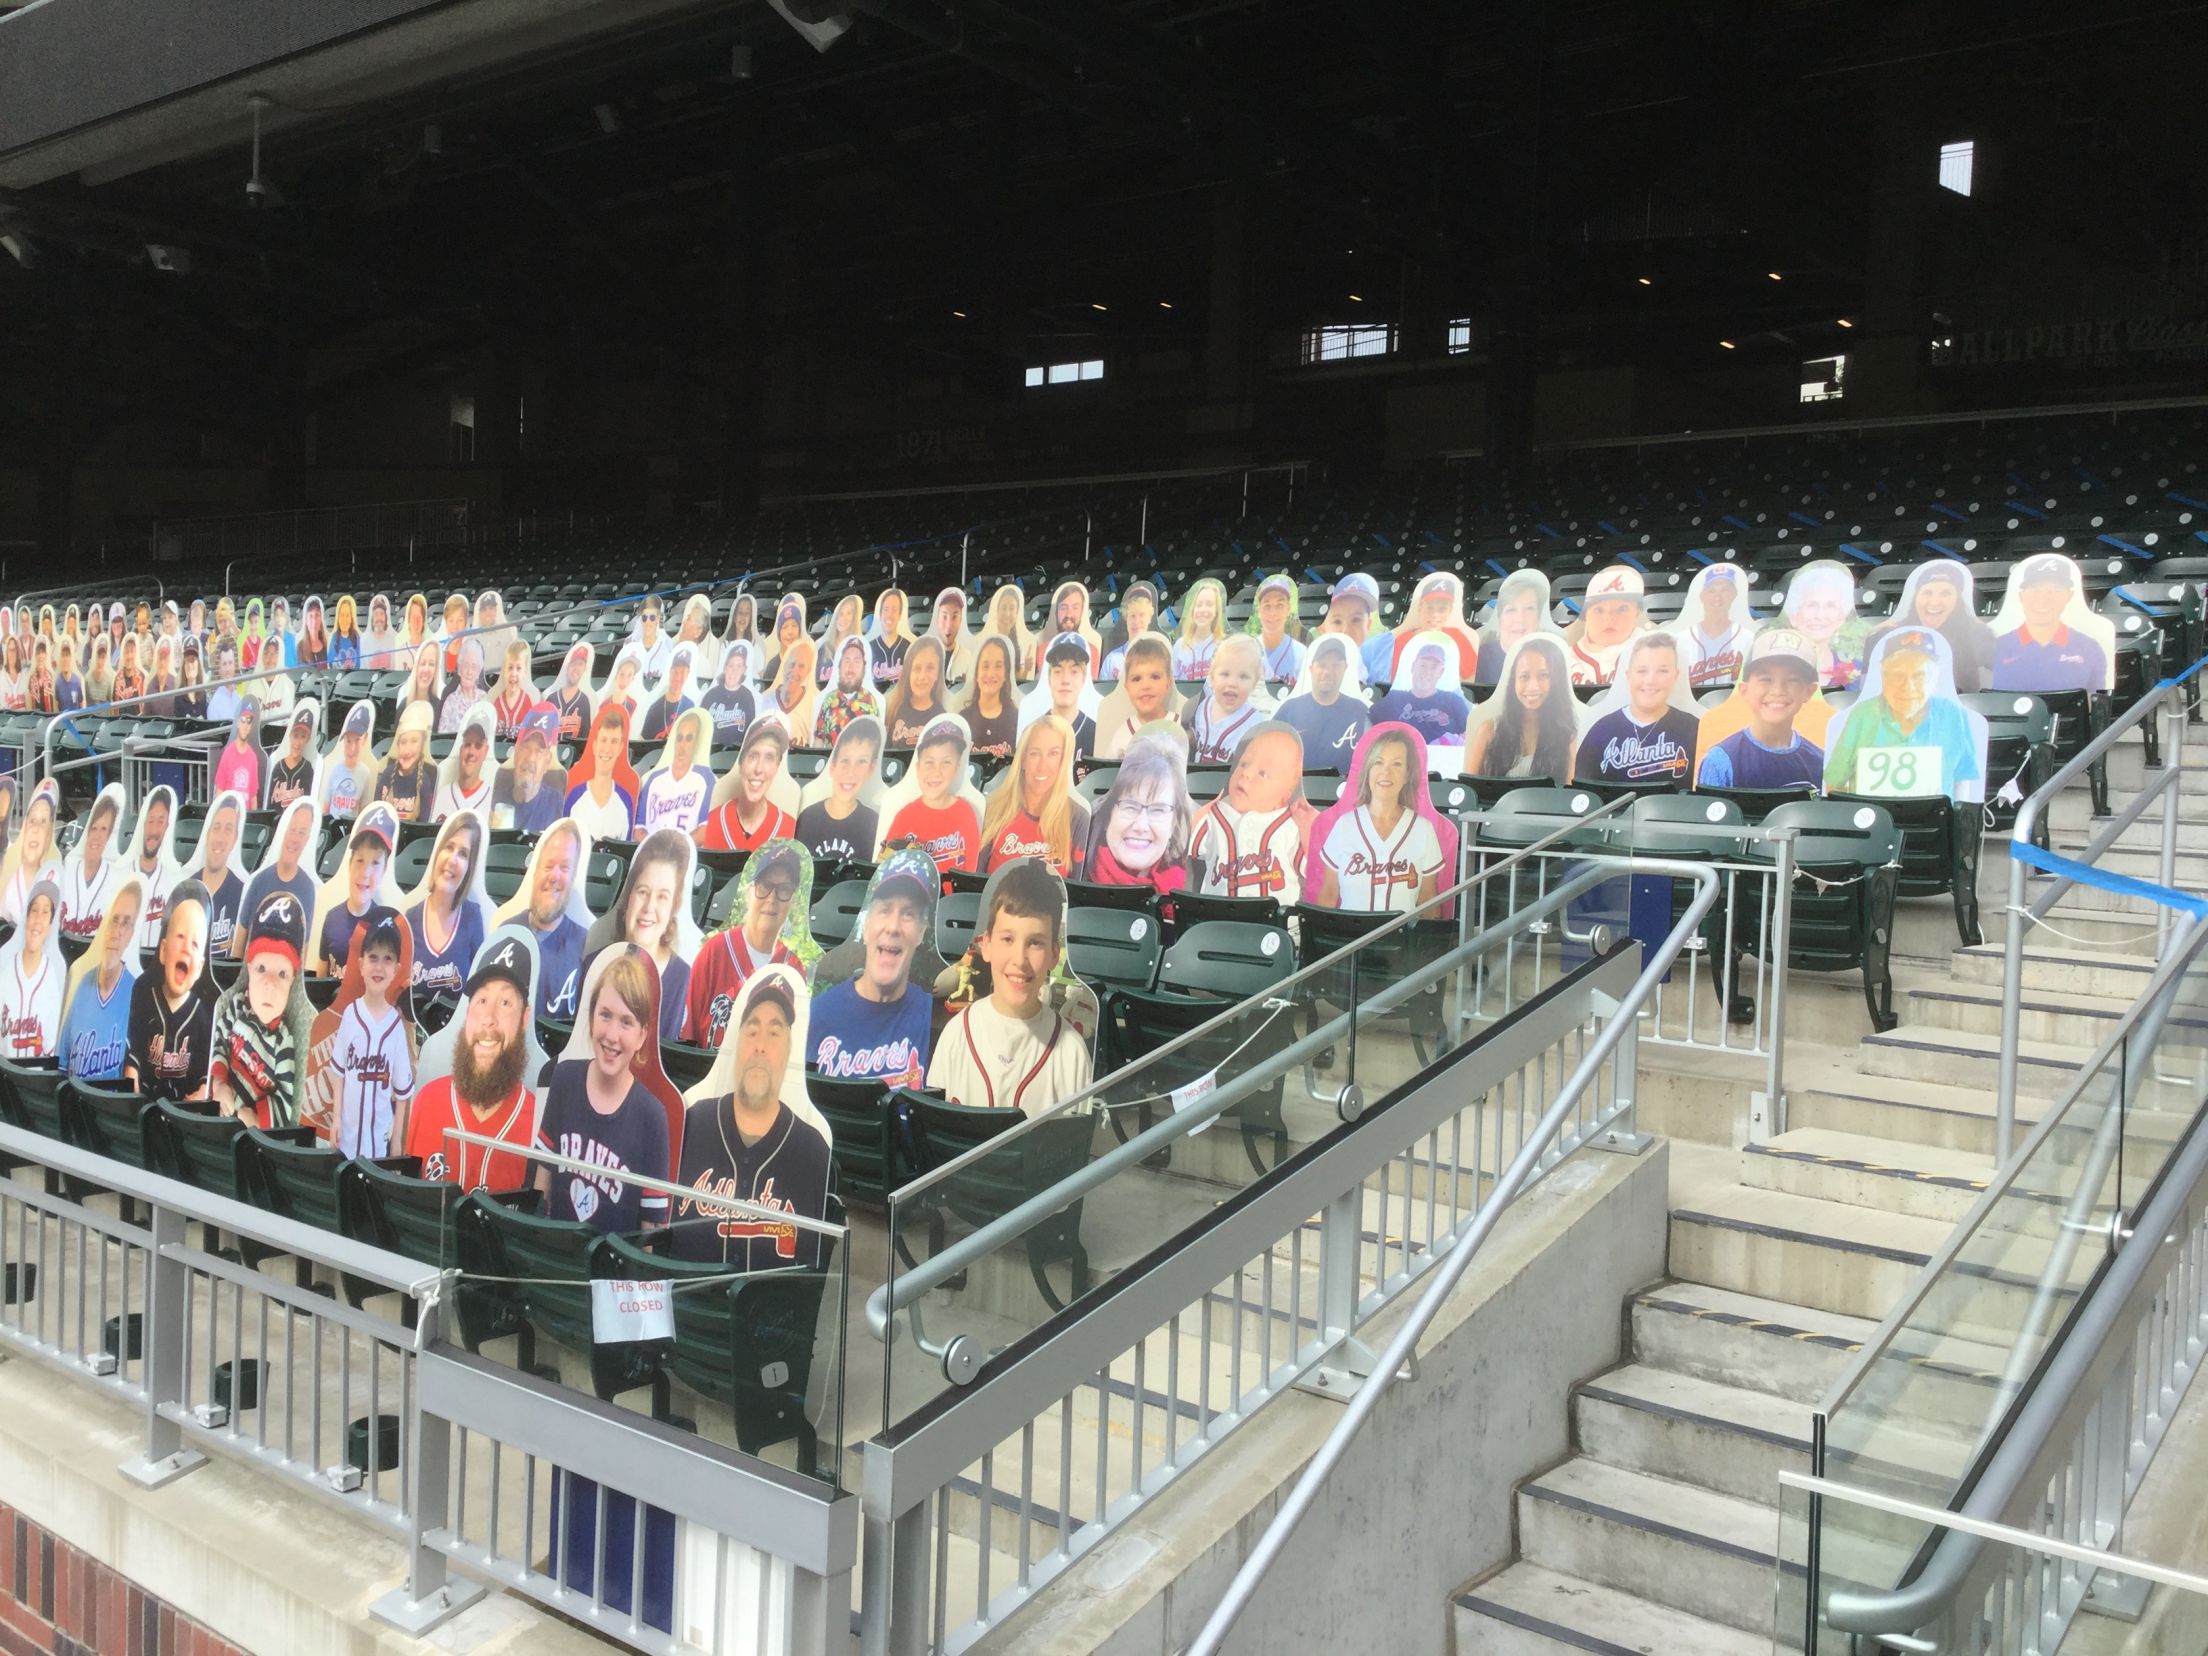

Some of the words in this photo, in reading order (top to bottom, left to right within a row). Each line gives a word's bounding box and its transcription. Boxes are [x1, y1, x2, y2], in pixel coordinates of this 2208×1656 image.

[1603, 575, 1624, 592] A
[1332, 721, 1359, 749] A
[1600, 731, 1675, 771] Atlanta
[1868, 751, 1917, 792] 98
[366, 808, 384, 825] A
[649, 790, 699, 823] Braves
[676, 815, 689, 831] 5
[1344, 852, 1409, 876] Braves
[259, 897, 292, 923] A
[490, 942, 515, 968] A
[547, 968, 578, 1016] A
[68, 1023, 122, 1079] Atlanta
[346, 1043, 386, 1071] Braves
[817, 1035, 910, 1077] Braves
[559, 1132, 631, 1204] BRAVES
[610, 1281, 634, 1293] THIS
[638, 1281, 664, 1293] ROW
[620, 1300, 664, 1313] CLOSED
